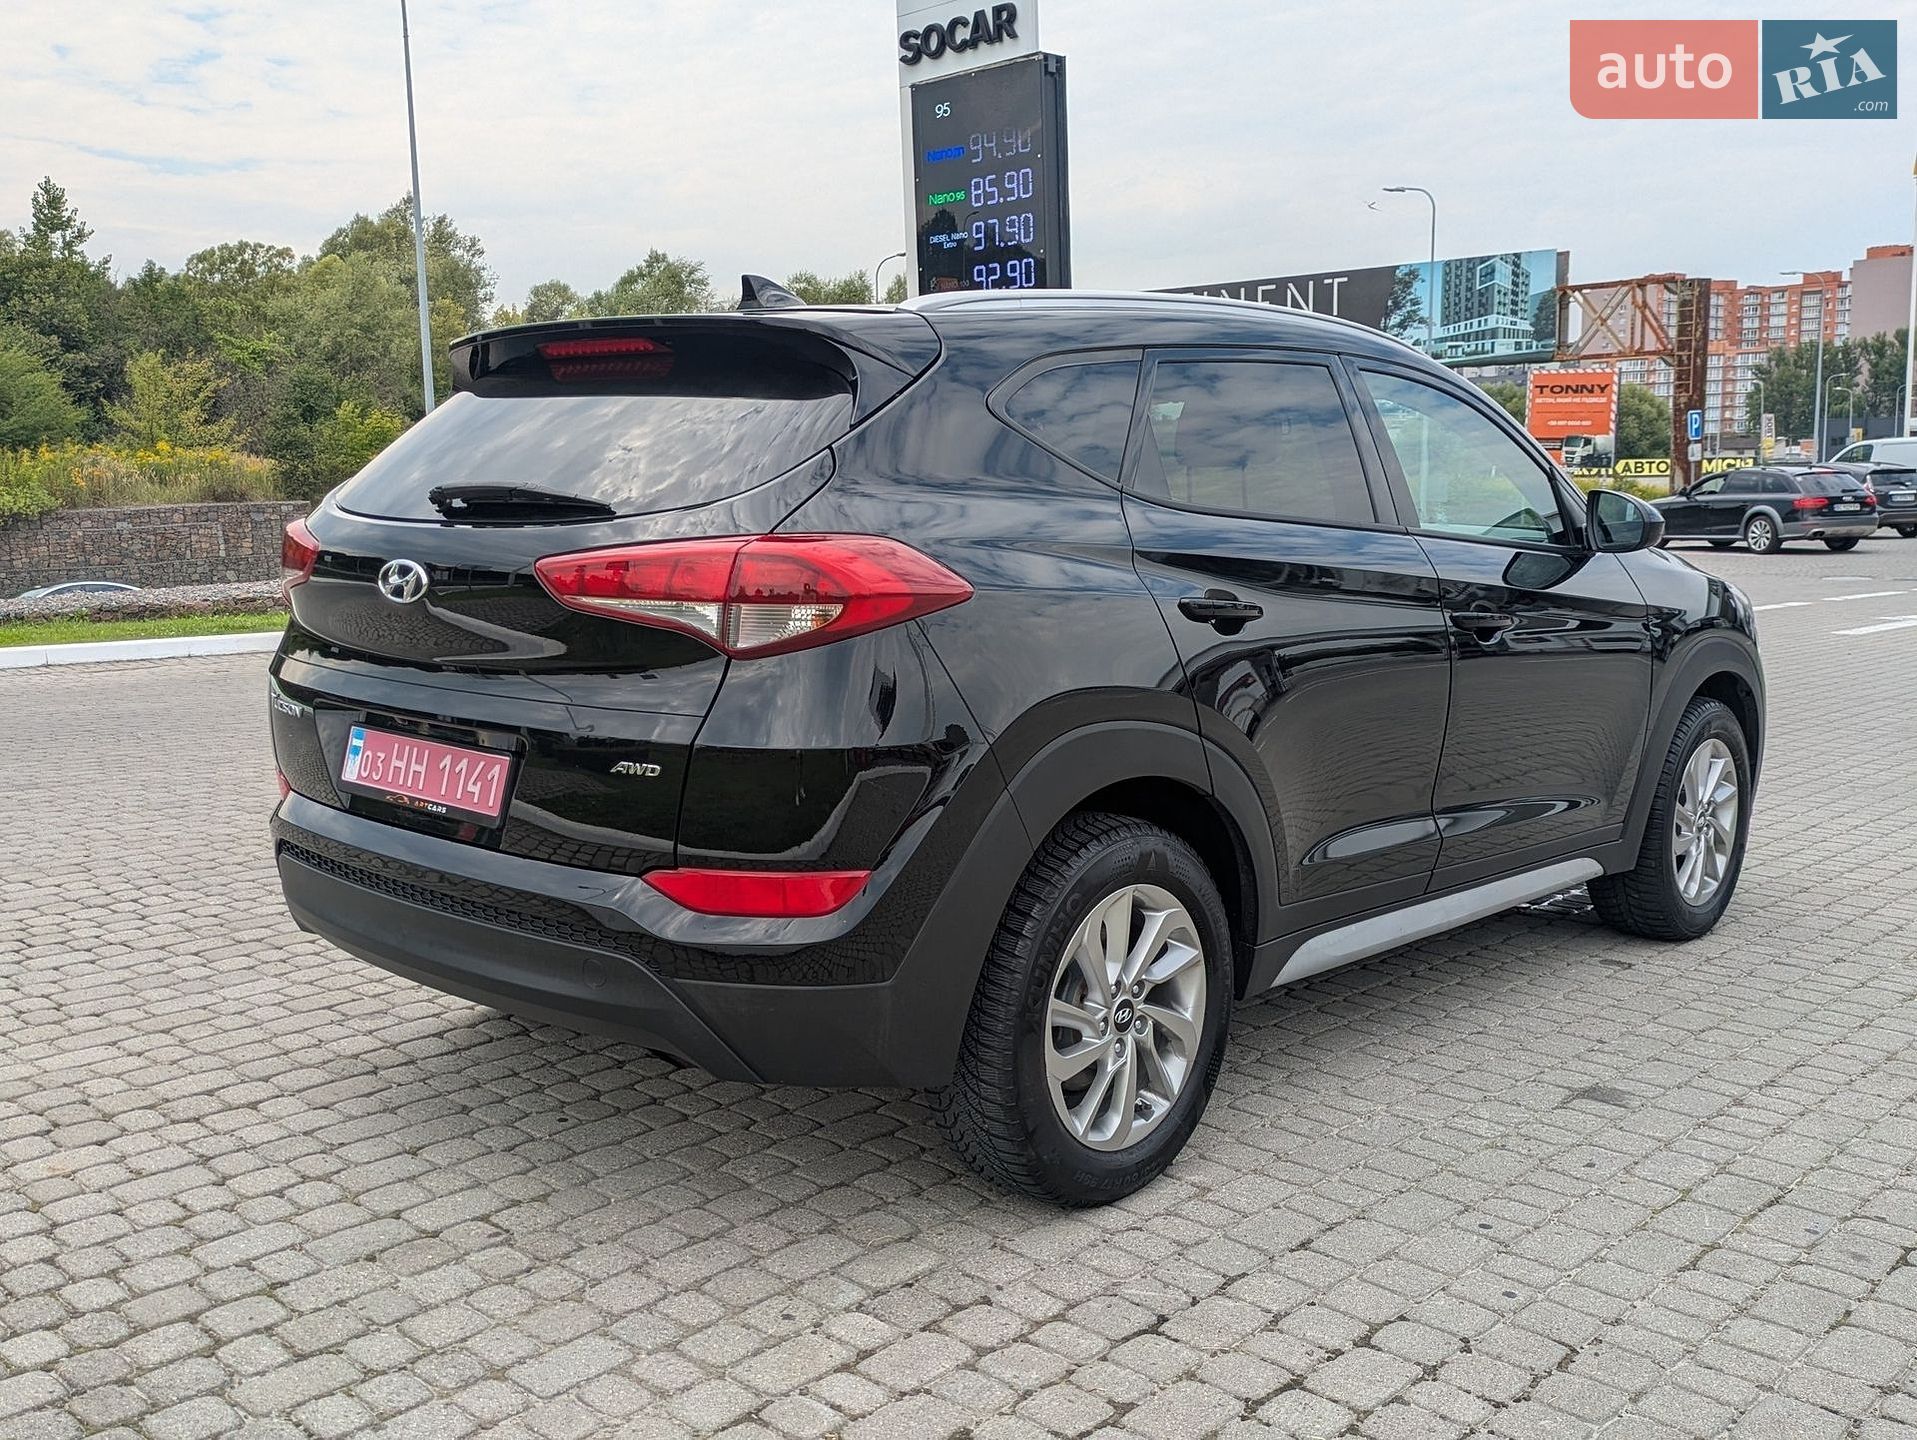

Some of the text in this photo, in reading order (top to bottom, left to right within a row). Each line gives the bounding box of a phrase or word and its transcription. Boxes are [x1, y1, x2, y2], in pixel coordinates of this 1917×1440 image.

[899, 2, 1019, 65] SOCAR
[935, 102, 951, 119] 95
[969, 128, 1031, 163] 94.90
[971, 167, 1033, 207] 85.90
[929, 234, 951, 244] DIESEL
[972, 212, 1034, 251] 97.90
[974, 257, 1035, 291] 92.90
[1534, 383, 1610, 395] TONNY
[1691, 413, 1701, 437] P
[360, 742, 501, 808] 03 HH 1141
[610, 761, 661, 777] AWD
